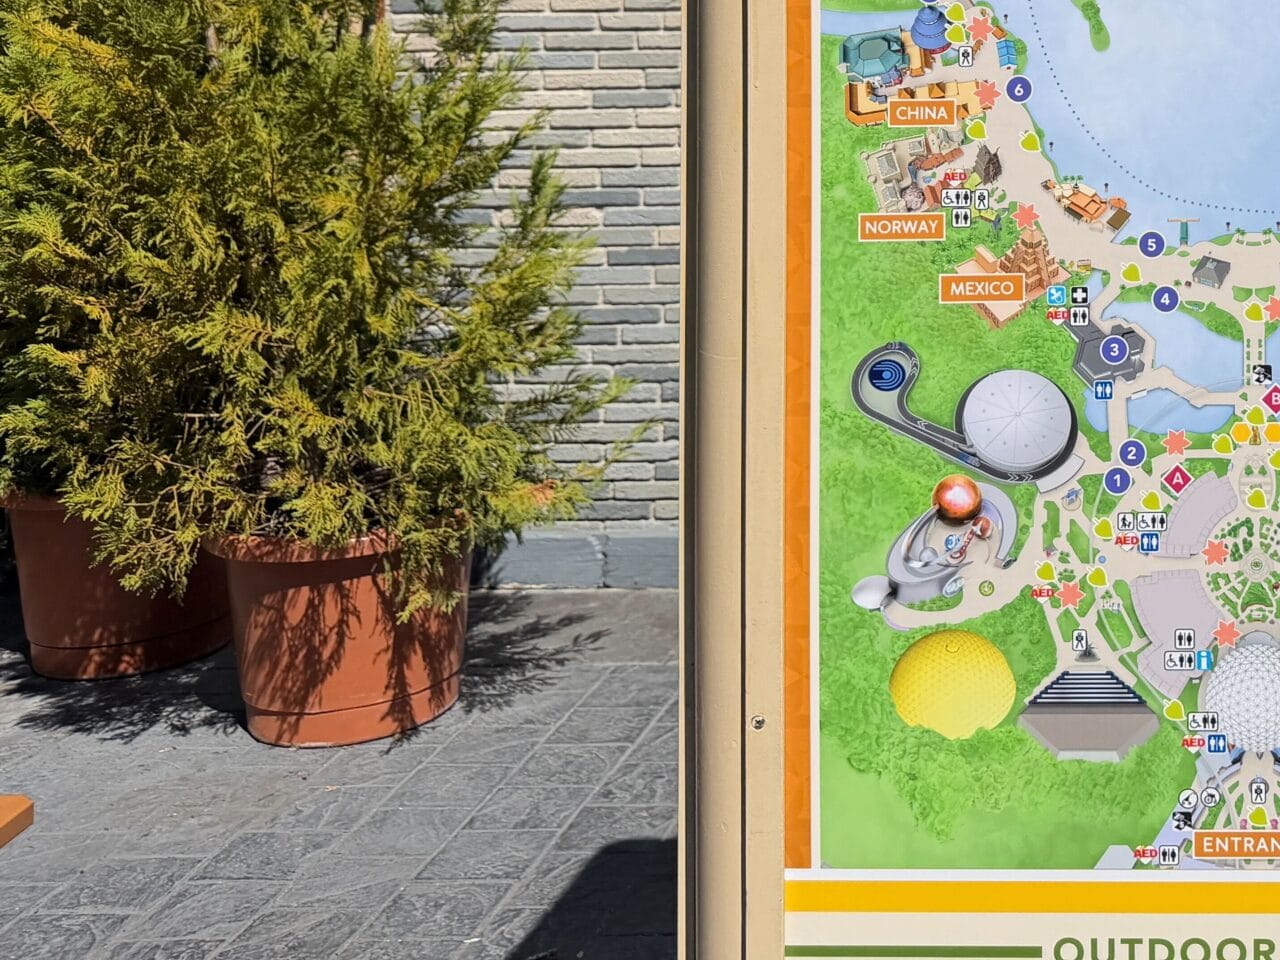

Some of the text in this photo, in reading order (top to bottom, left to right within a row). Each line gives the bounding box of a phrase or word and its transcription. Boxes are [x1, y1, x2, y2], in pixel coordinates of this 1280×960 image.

[1014, 83, 1024, 97] 6
[895, 106, 948, 121] CHINA
[943, 172, 966, 181] AED
[865, 219, 938, 235] NORWAY
[1147, 238, 1157, 252] 5
[950, 280, 1015, 296] MEXICO
[1160, 292, 1171, 306] 4
[1046, 310, 1069, 320] AED
[1110, 343, 1120, 357] 3
[1127, 446, 1137, 460] 2
[1113, 473, 1121, 487] 1
[1172, 471, 1184, 485] A
[1115, 536, 1139, 545] AED
[1031, 589, 1054, 598] AED
[1182, 738, 1205, 748] AED
[1134, 849, 1157, 858] AED
[1053, 937, 1276, 960] OUTDOOR
